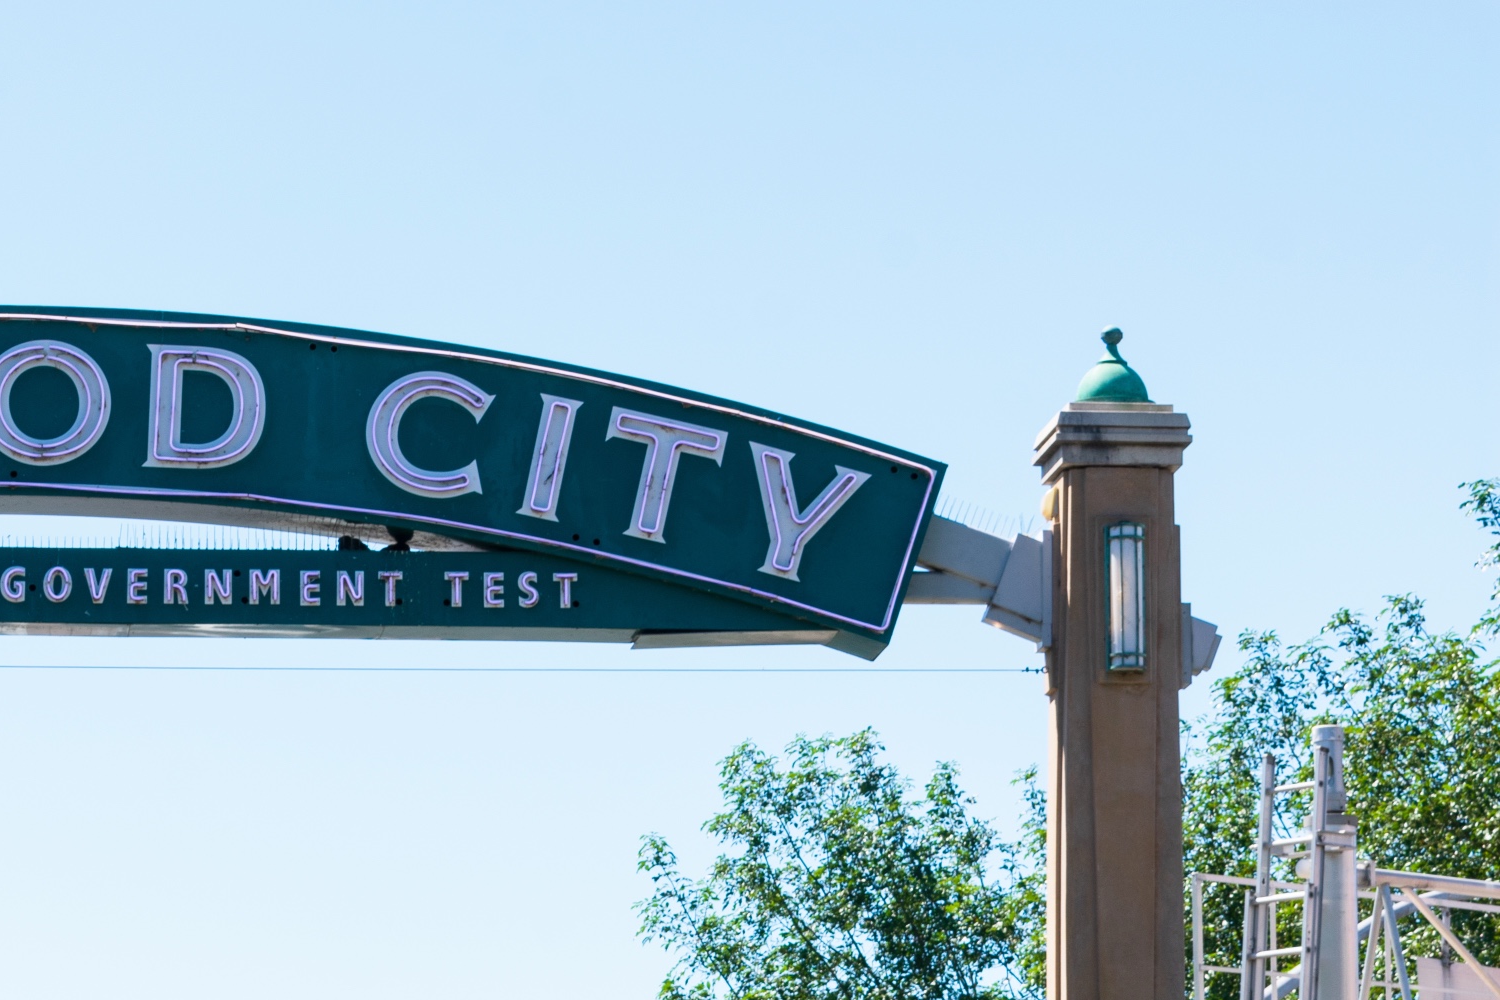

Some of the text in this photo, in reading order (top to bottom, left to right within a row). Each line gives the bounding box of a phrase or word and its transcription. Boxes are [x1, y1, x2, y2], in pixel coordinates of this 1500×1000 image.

[366, 370, 872, 582] CITY
[0, 566, 403, 607] GOVERNMENT
[444, 571, 578, 609] TEST
